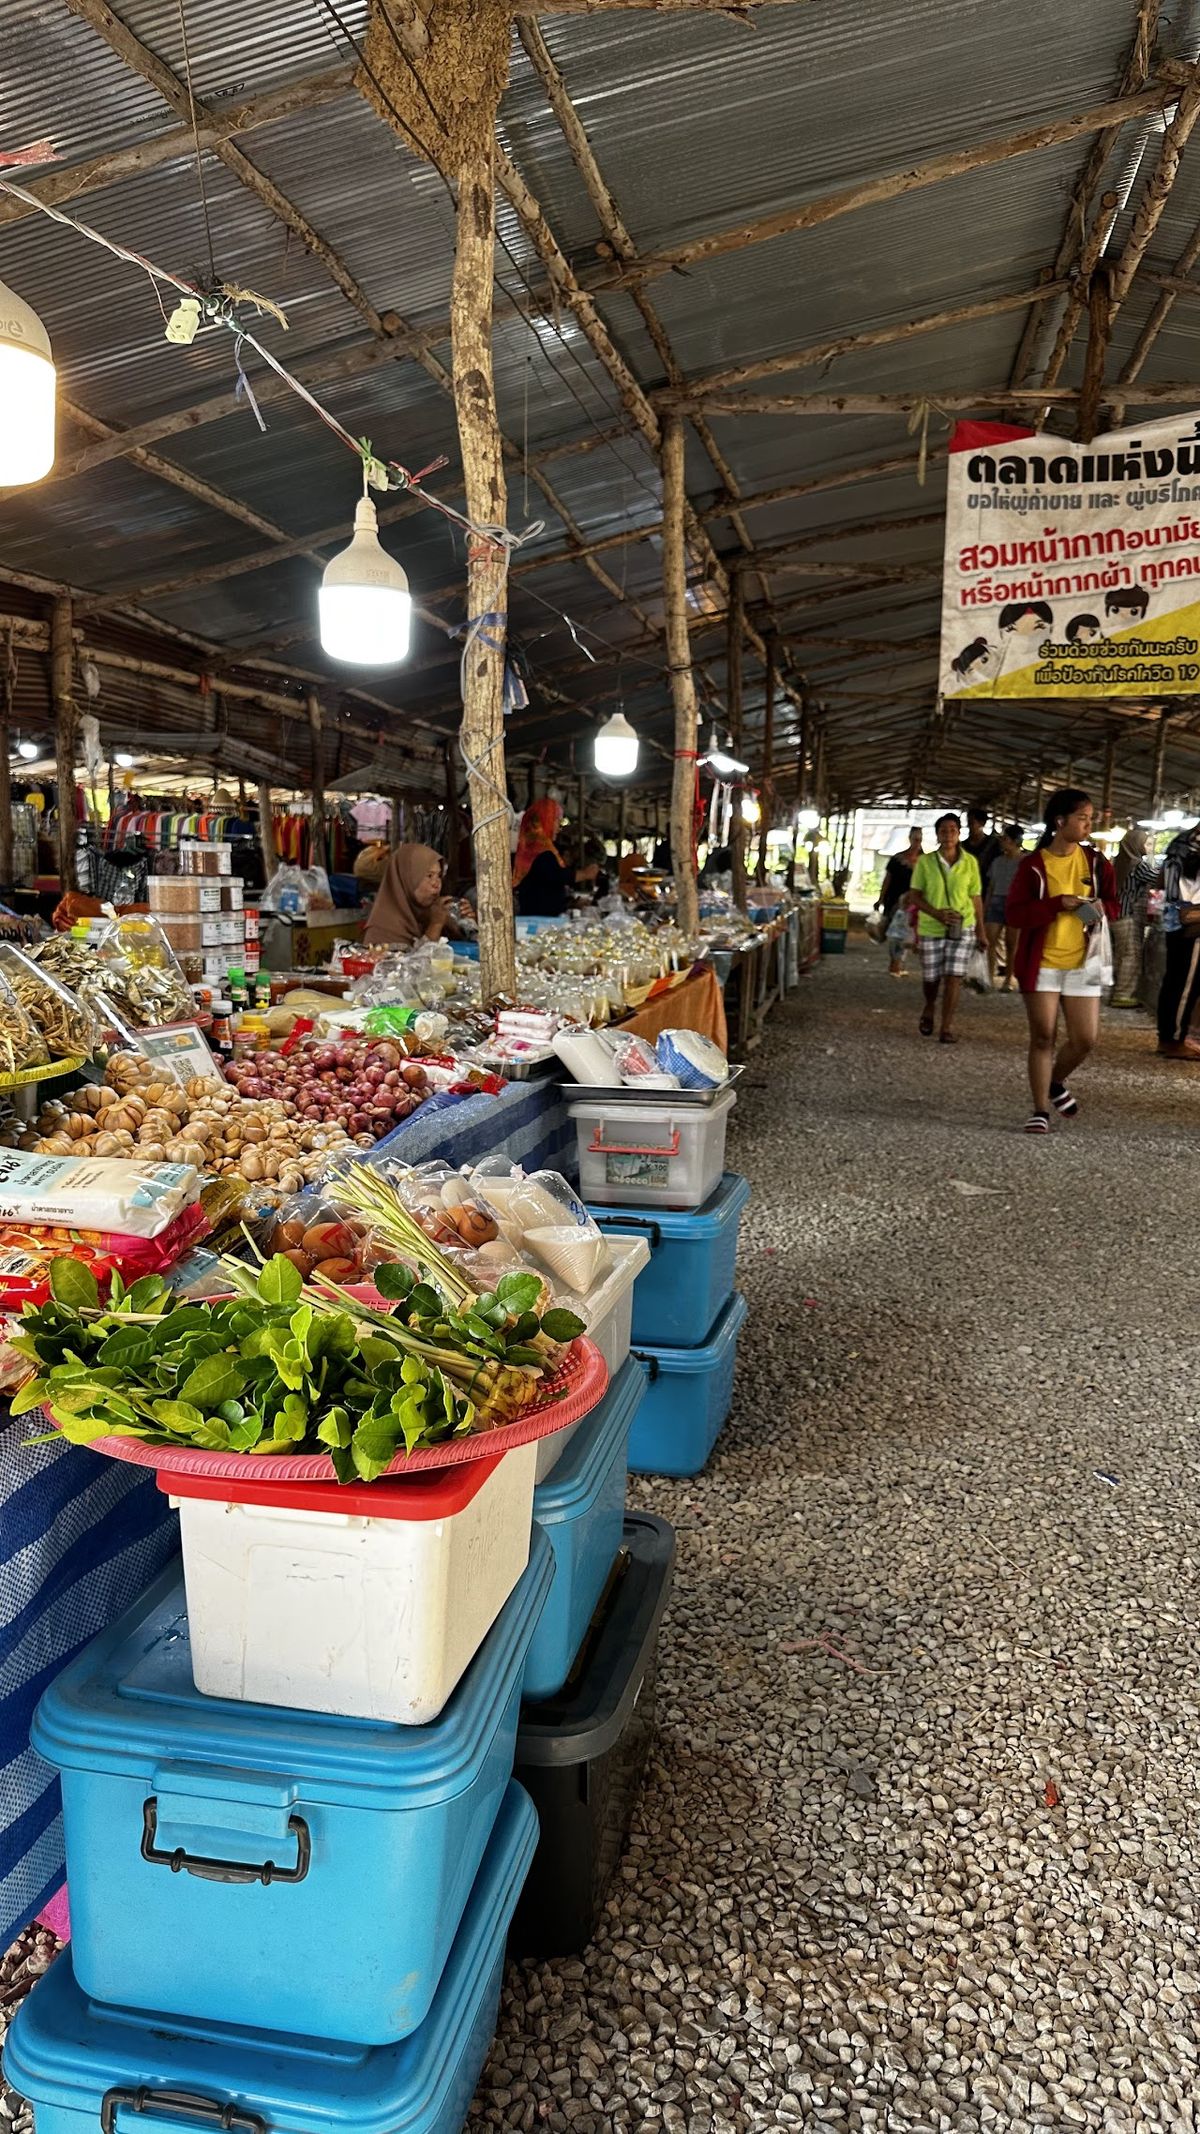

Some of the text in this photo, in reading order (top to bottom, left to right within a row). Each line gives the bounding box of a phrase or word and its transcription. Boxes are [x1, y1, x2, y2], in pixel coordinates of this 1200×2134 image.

[968, 421, 1200, 484] ตลาดแห่งนี้
[968, 487, 1082, 515] ขอให้ผู้ค้าขาย
[1088, 492, 1120, 508] และ
[961, 562, 1131, 606] หรือหน้ากากผ้า
[1038, 637, 1198, 658] ร่วมด้วยช่วยกันนะครับ
[1035, 662, 1200, 684] เพื่อป้องกันโรคโควิด 19
